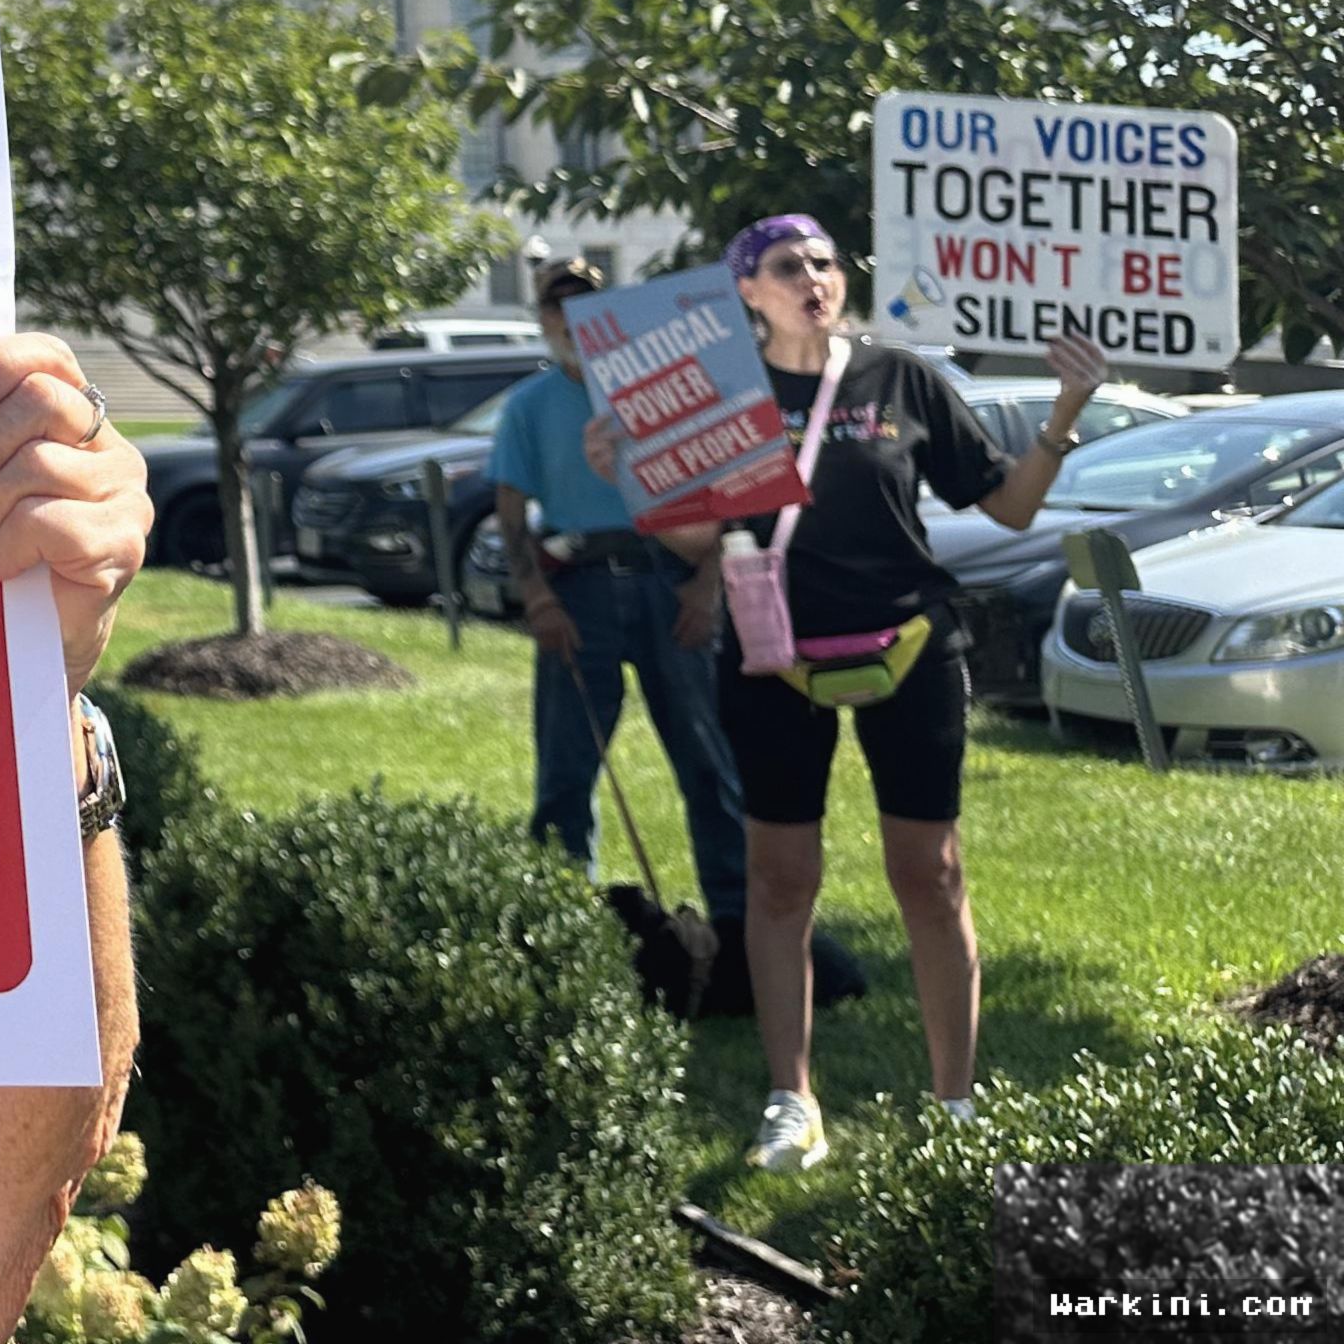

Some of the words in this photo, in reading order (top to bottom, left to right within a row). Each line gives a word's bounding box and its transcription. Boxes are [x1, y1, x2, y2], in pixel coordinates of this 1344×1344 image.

[902, 108, 997, 154] OUR
[1035, 115, 1207, 169] VOICES
[892, 160, 1218, 242] TOGETHER
[935, 233, 1081, 289] WON'T
[1123, 250, 1183, 298] BE
[575, 310, 629, 354] ALL
[590, 305, 733, 395] POLITICAL
[954, 294, 1195, 356] SILENCED
[613, 362, 715, 434] POWER
[637, 451, 687, 494] THE
[677, 414, 762, 476] PEOPLE
